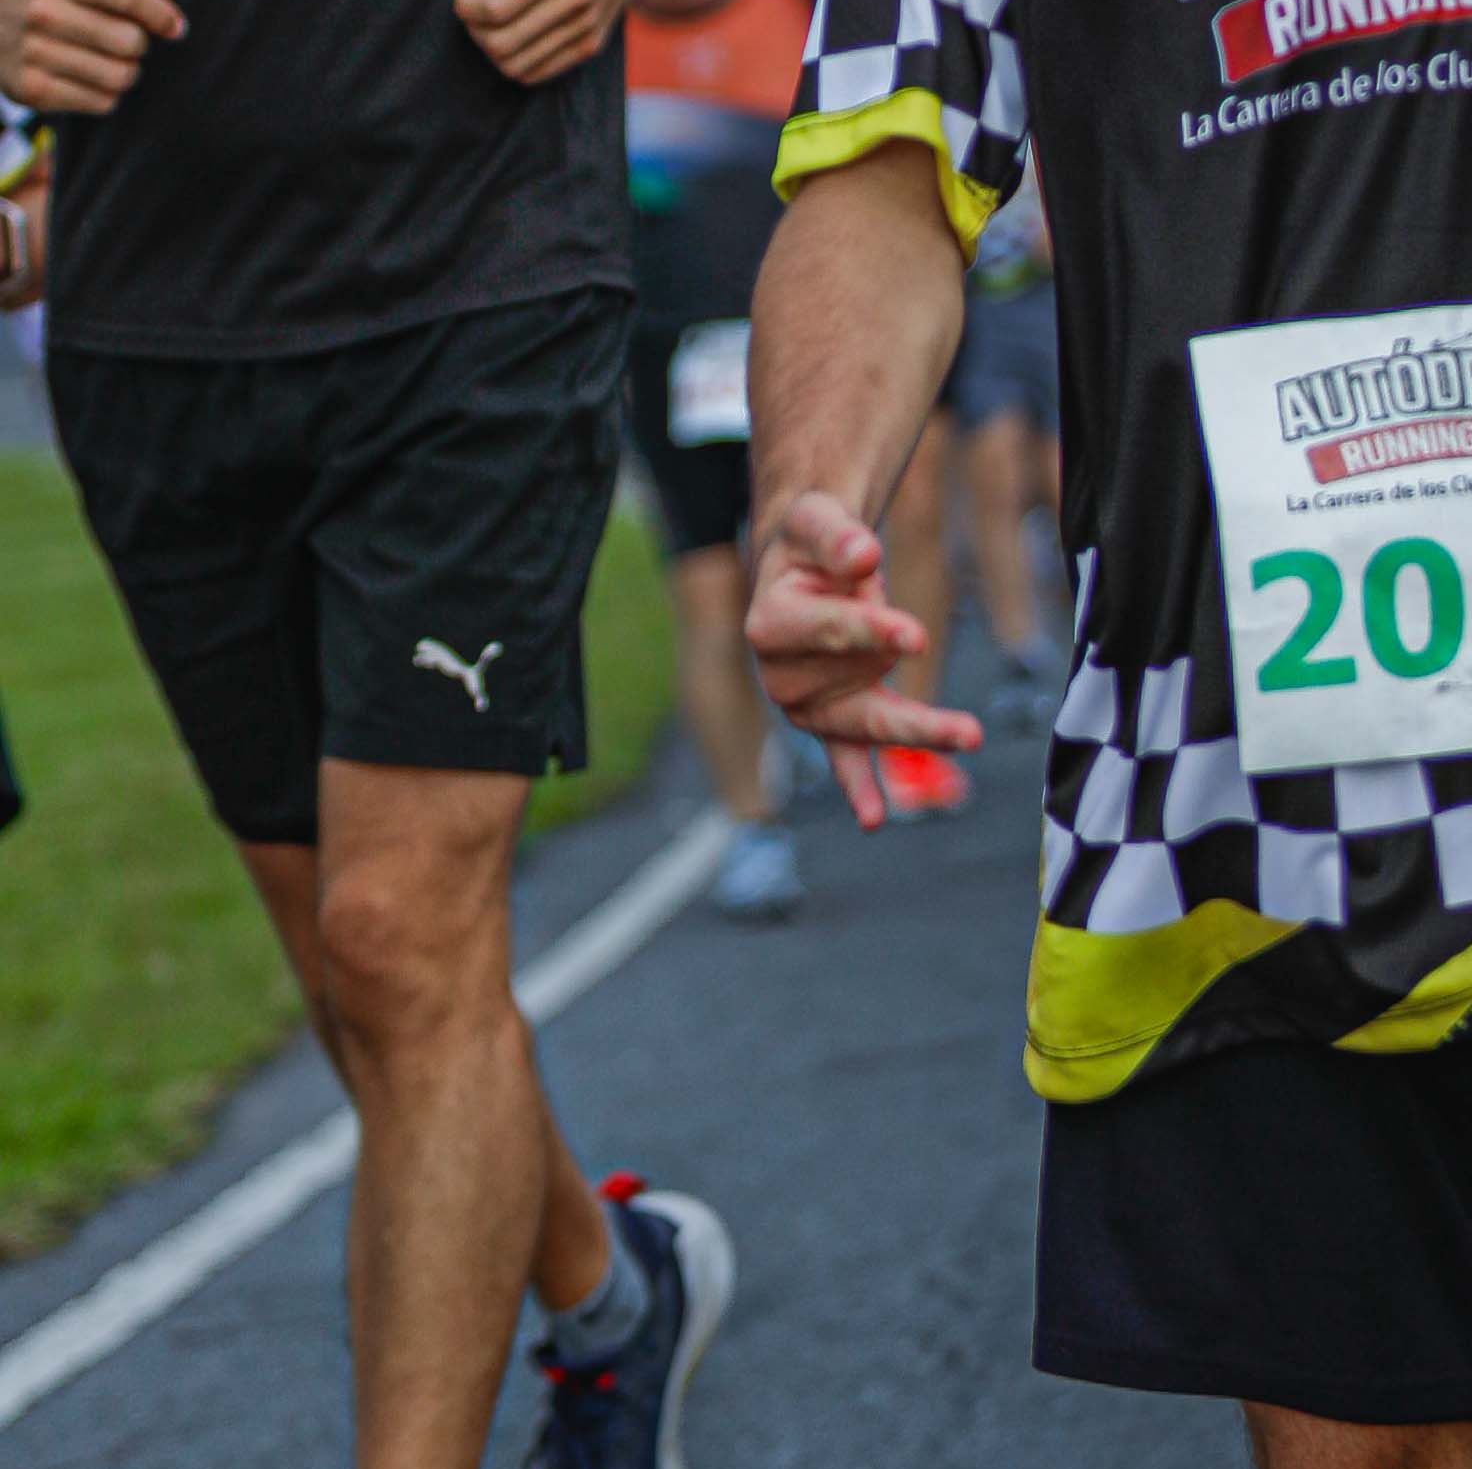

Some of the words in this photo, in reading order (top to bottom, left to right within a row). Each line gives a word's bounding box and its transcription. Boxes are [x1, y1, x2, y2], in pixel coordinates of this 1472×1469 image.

[1180, 110, 1214, 148] La
[1217, 80, 1322, 133] Carrera
[1328, 65, 1374, 108] de
[1375, 59, 1422, 94] los
[1286, 492, 1308, 512] La
[1313, 485, 1385, 509] Carrera
[1390, 481, 1415, 501] de
[1419, 477, 1447, 497] los
